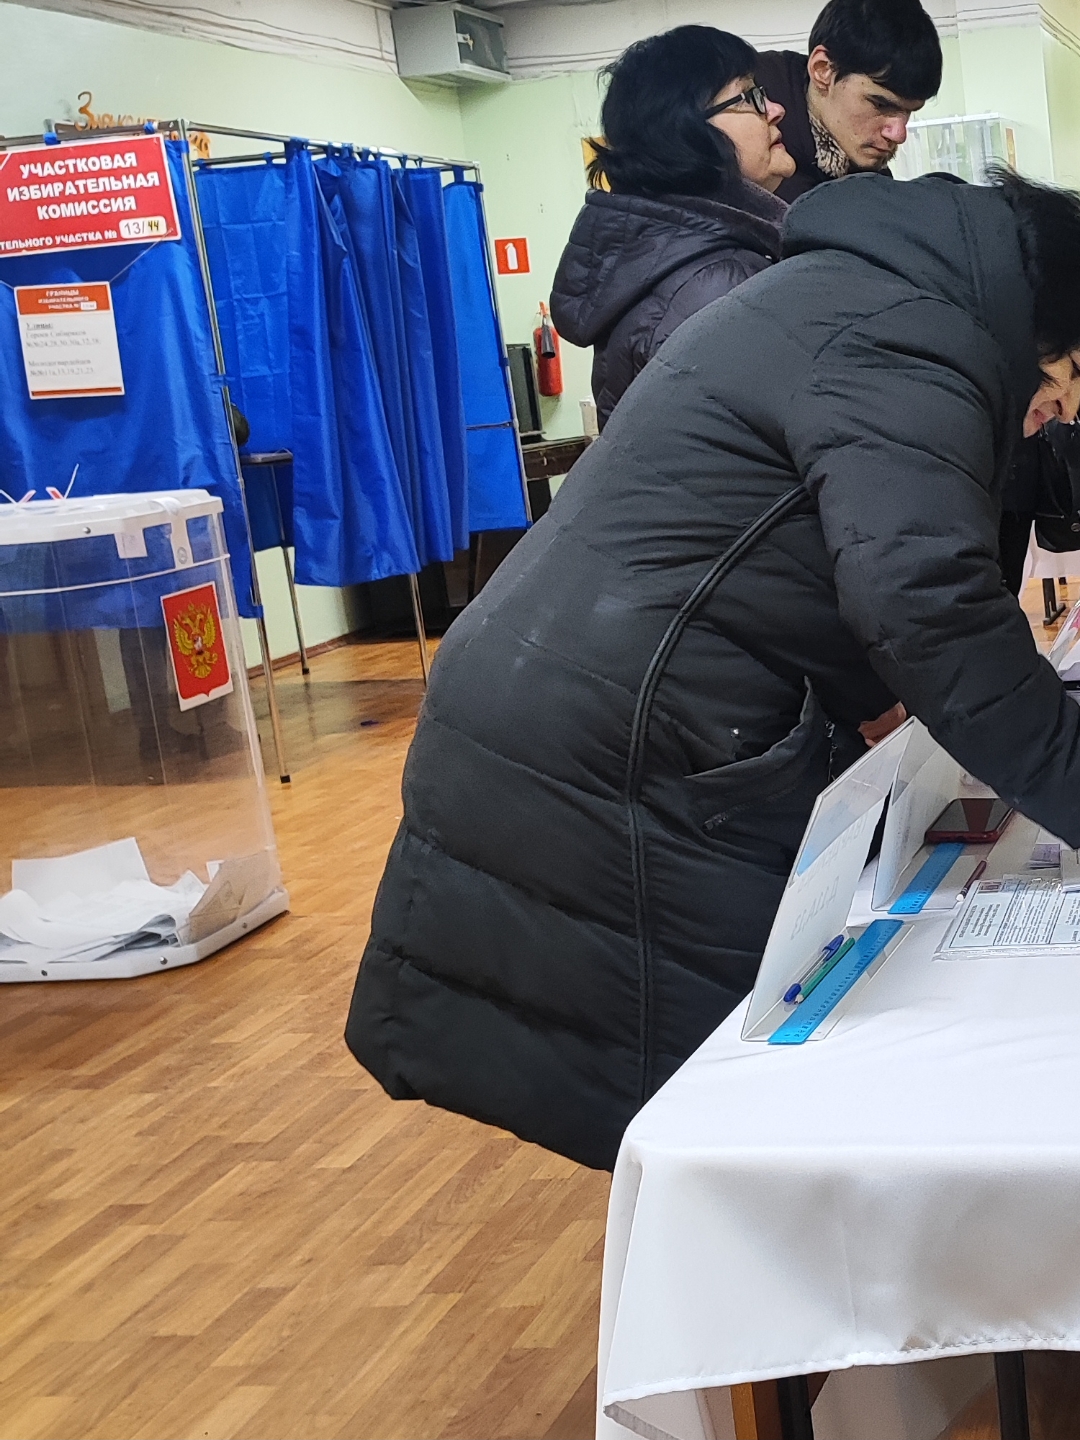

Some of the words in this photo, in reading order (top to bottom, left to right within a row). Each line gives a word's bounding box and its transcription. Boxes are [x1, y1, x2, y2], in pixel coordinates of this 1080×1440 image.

[20, 152, 138, 179] УЧАСТКОВАЯ
[7, 171, 161, 203] ИЗБИРАТЕЛЬНАЯ
[36, 195, 137, 221] КОМИССИЯ
[0, 235, 54, 251] ТЕЛЬНОГО
[55, 230, 104, 246] УЧАСТКА
[104, 229, 118, 240] №
[123, 219, 161, 237] 13/44
